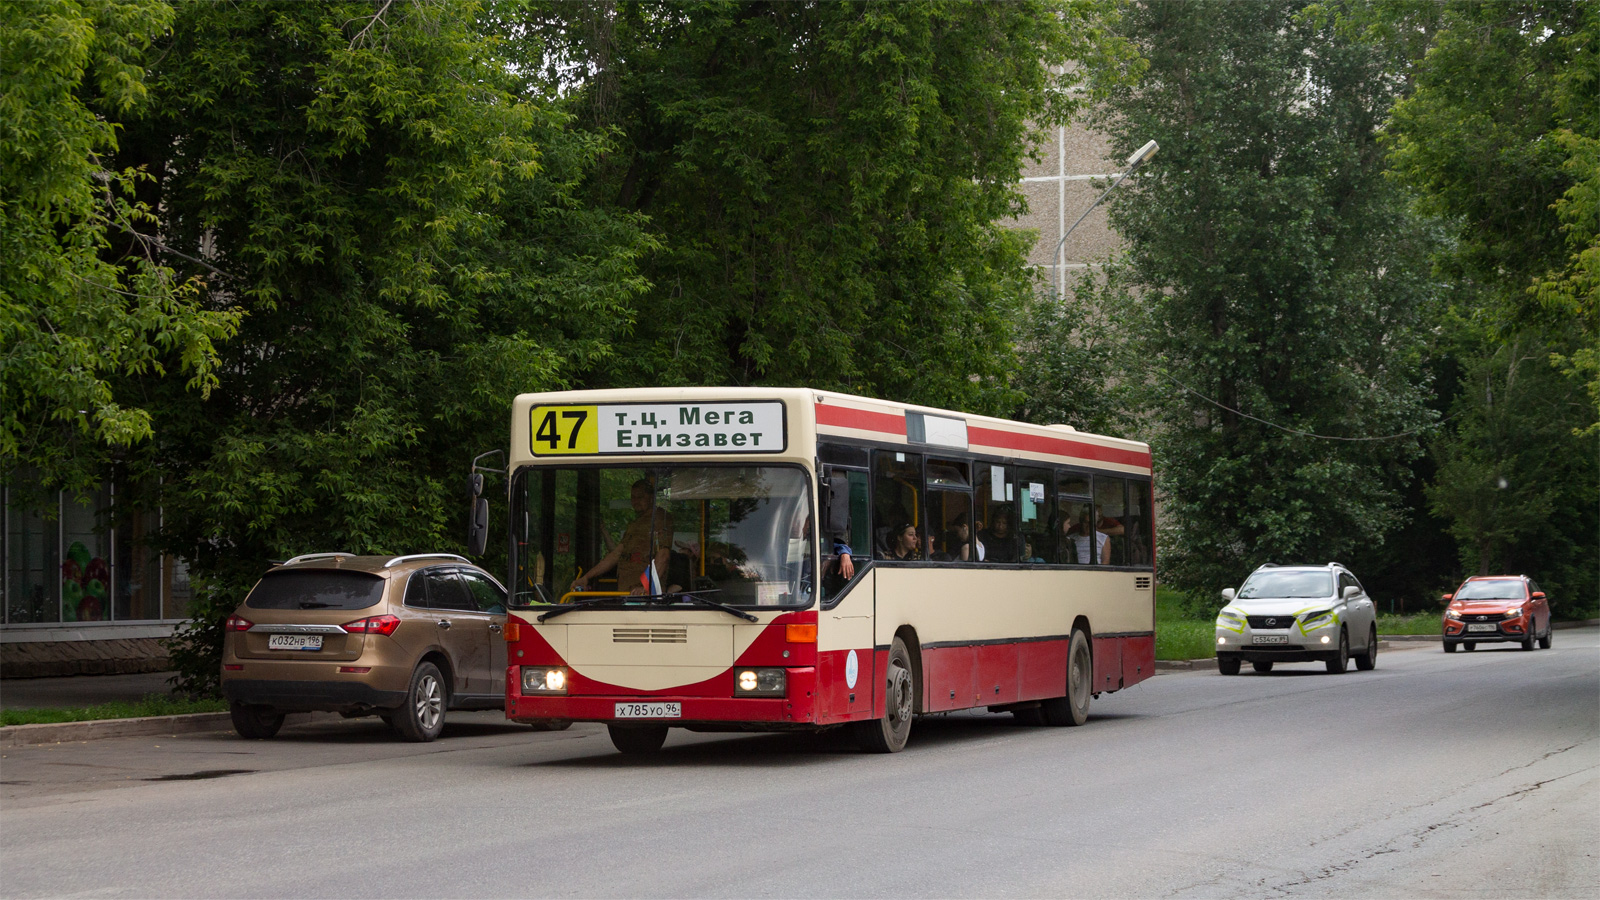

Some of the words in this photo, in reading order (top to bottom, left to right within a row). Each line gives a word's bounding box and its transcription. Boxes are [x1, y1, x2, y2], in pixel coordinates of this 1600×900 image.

[615, 412, 667, 428] т.ц.
[679, 407, 754, 425] Мега
[536, 411, 587, 449] 47
[617, 430, 763, 448] Елизавет
[619, 705, 663, 716] Х785УО
[665, 703, 677, 712] 96
